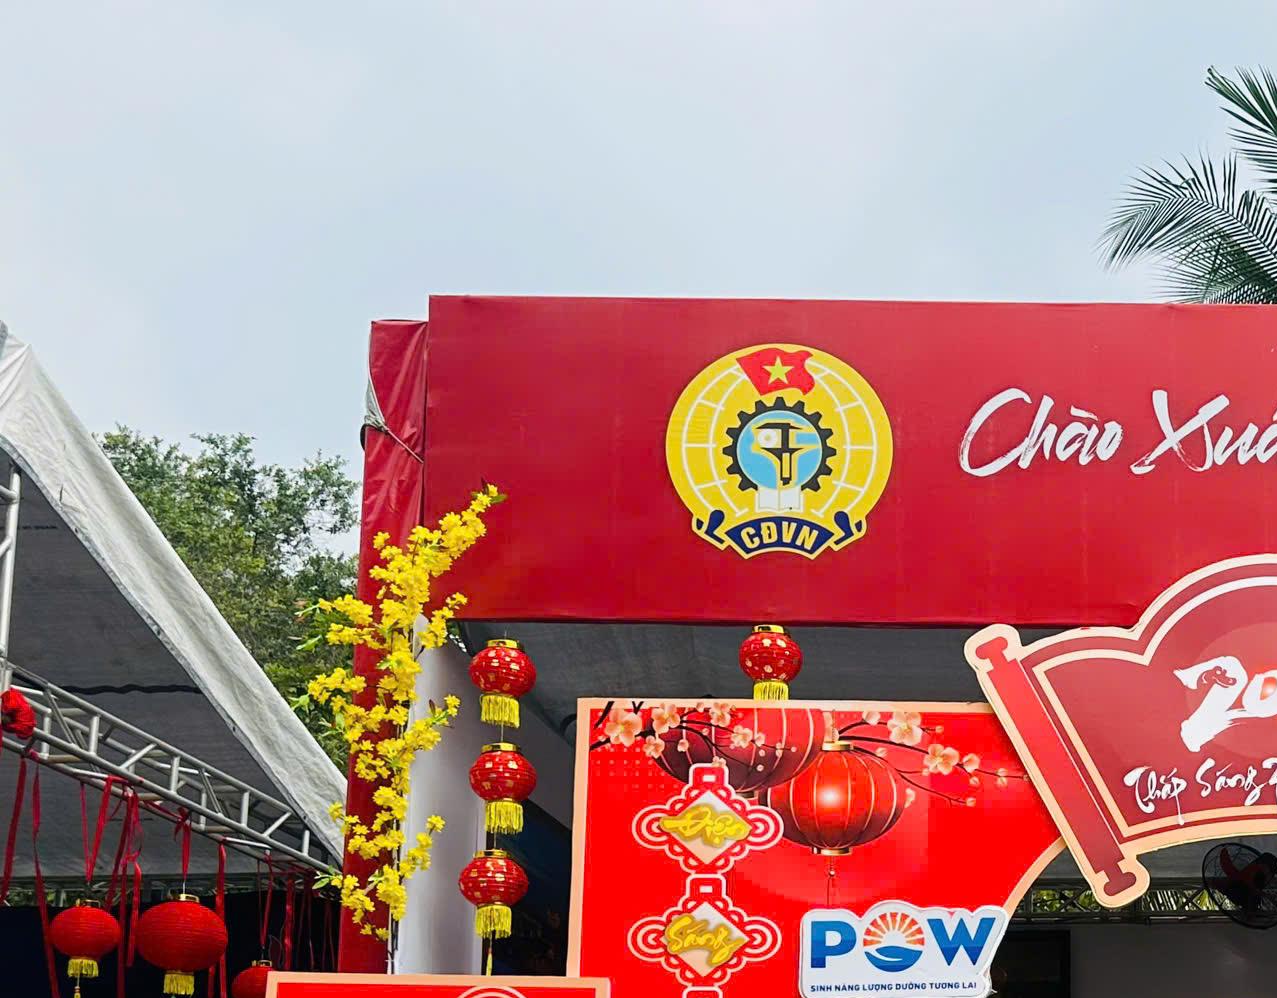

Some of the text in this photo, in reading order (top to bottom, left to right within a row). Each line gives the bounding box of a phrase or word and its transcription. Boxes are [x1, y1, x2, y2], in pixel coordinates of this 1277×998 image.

[958, 387, 1124, 477] Chào
[740, 521, 819, 549] CĐVN
[1196, 757, 1268, 806] Sáng
[810, 984, 832, 993] SINH
[962, 981, 977, 990] LAI
